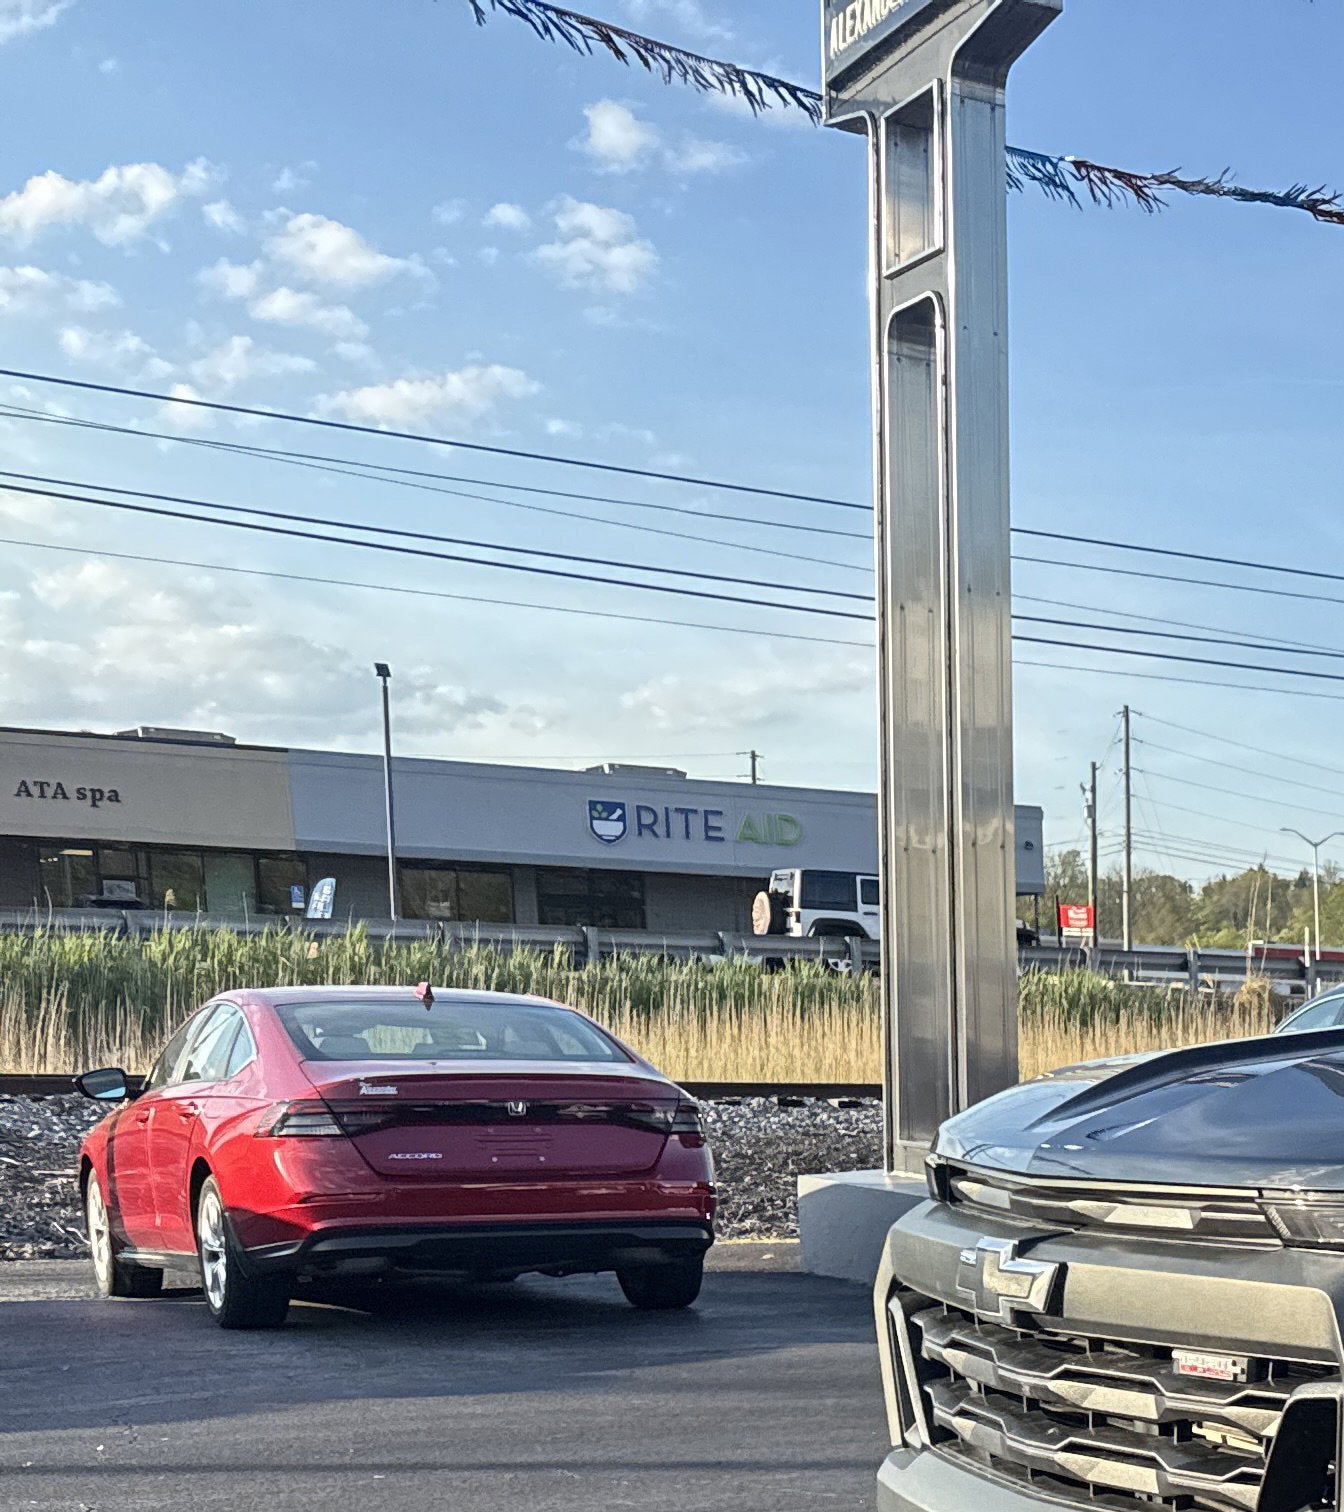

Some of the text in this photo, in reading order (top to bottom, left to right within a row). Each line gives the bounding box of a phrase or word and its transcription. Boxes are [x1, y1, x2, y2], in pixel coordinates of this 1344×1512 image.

[829, 0, 908, 60] ALEXAN
[13, 780, 122, 808] ATA spa
[635, 804, 804, 847] RITE AID
